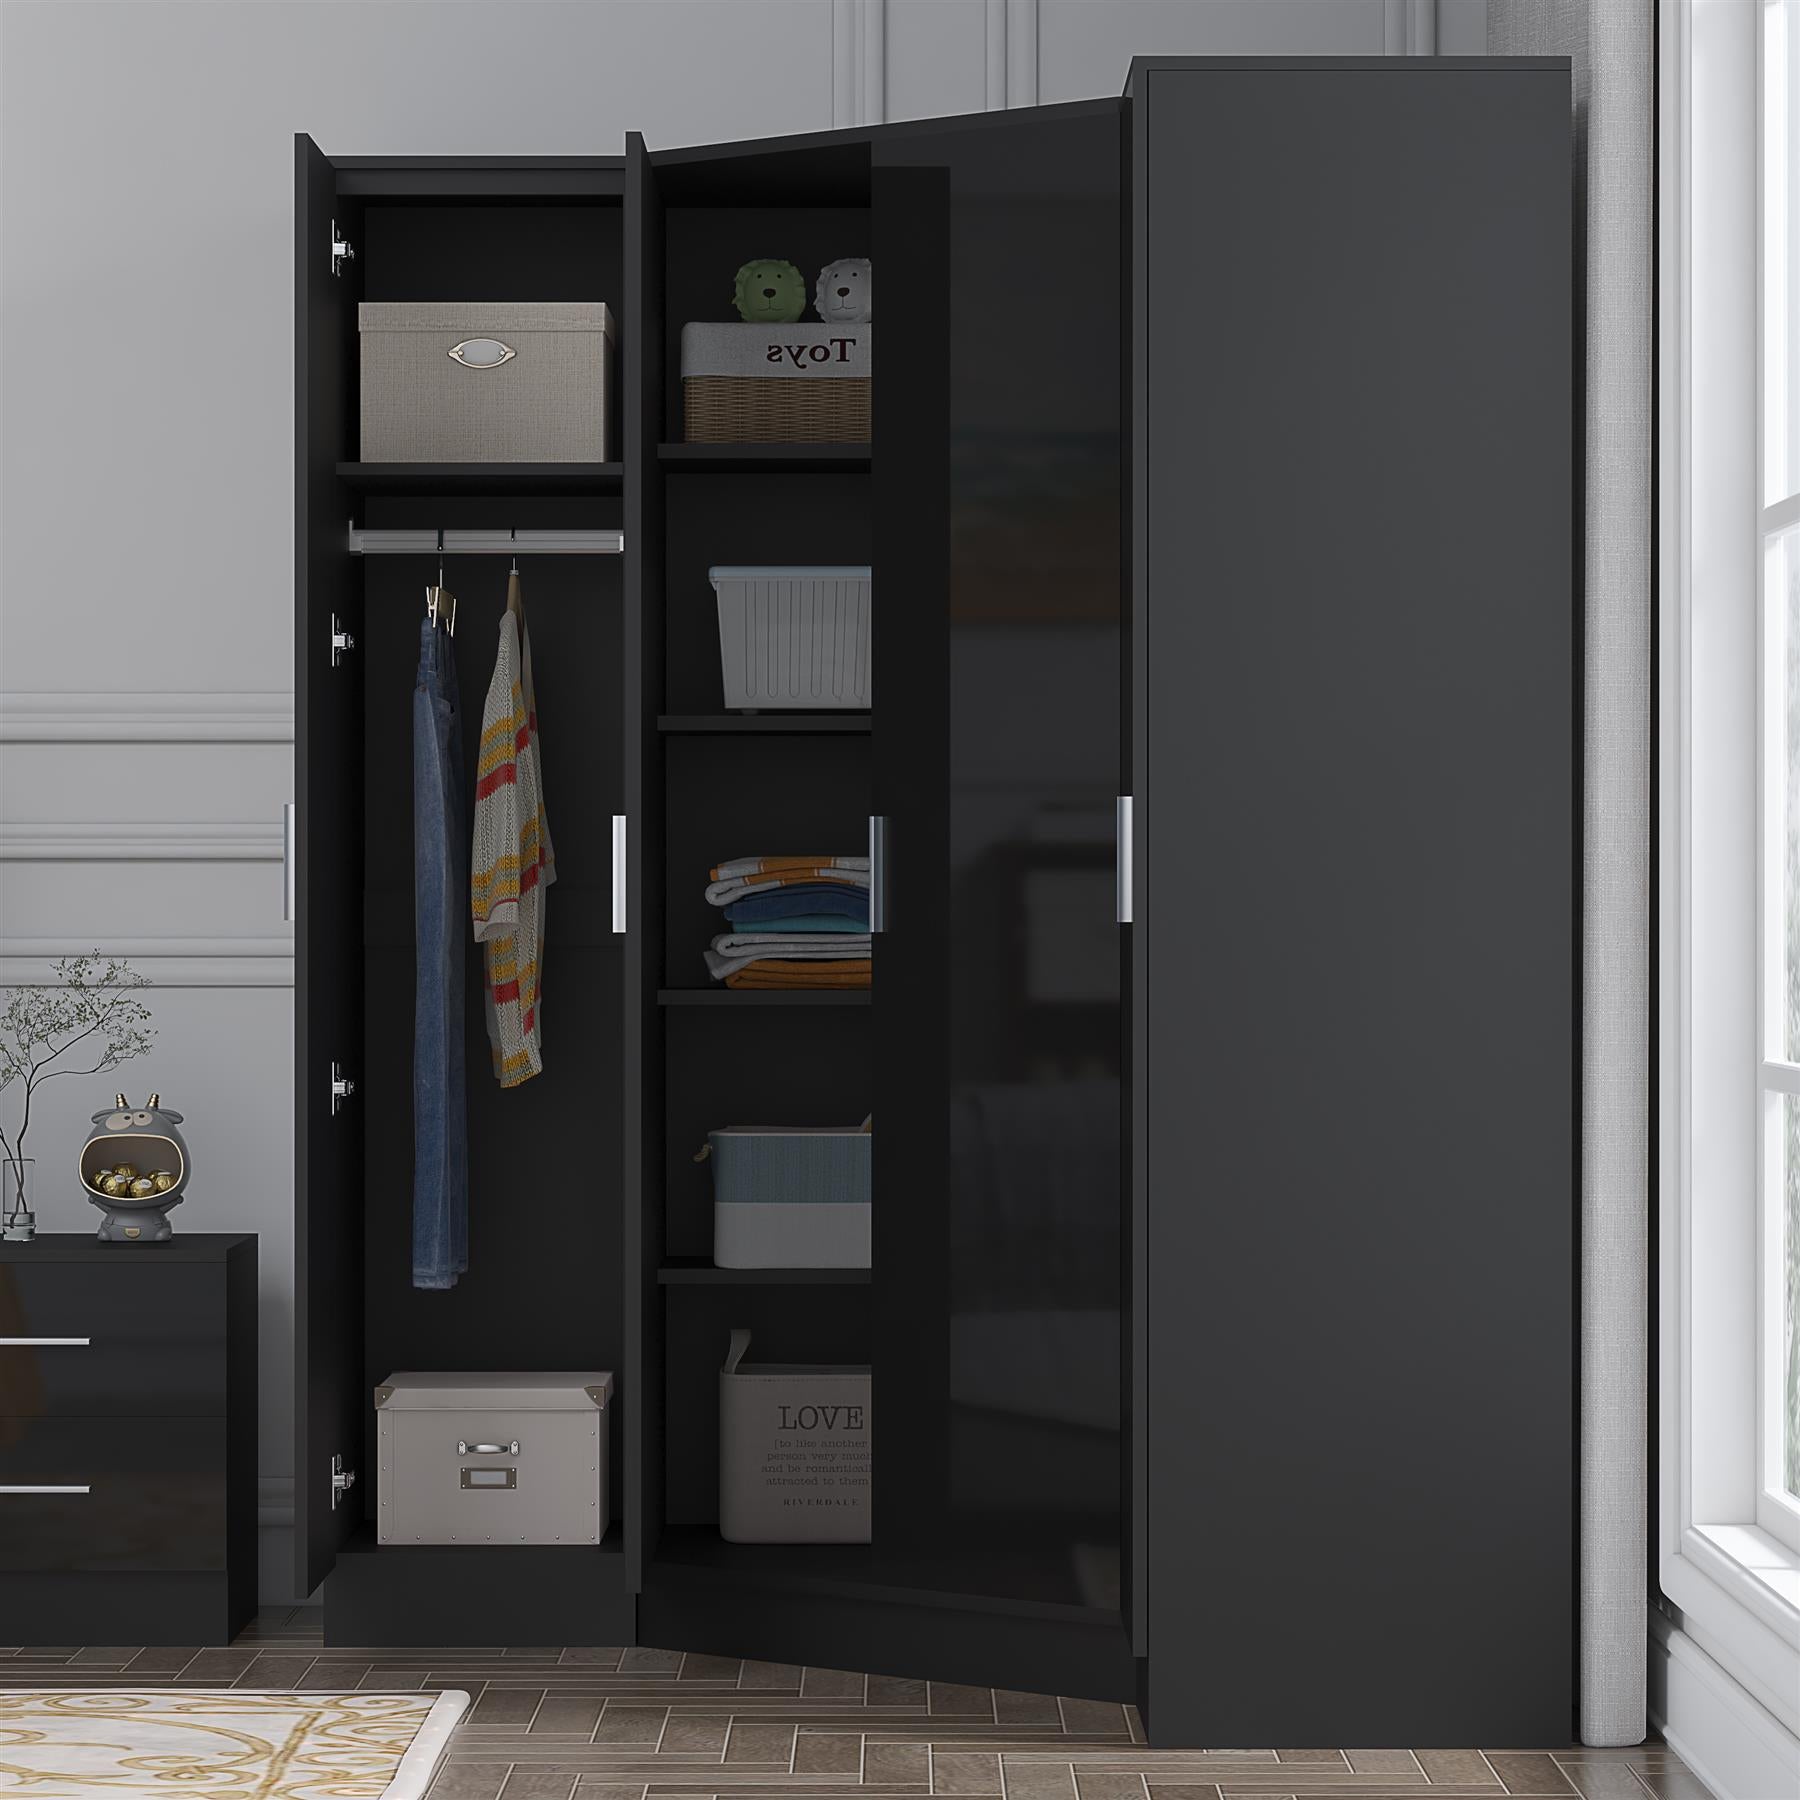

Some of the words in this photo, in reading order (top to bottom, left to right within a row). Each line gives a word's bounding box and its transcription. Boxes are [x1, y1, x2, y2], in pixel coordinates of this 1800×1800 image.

[777, 1405, 864, 1430] LOVE
[796, 1439, 817, 1448] like
[820, 1439, 868, 1448] another
[767, 1453, 807, 1463] person
[811, 1453, 836, 1462] very
[761, 1464, 783, 1473] and
[788, 1464, 801, 1473] be
[805, 1464, 871, 1473] romanticall
[766, 1477, 818, 1486] attracted
[823, 1477, 834, 1486] to
[783, 1498, 859, 1506] RIVERDALE
